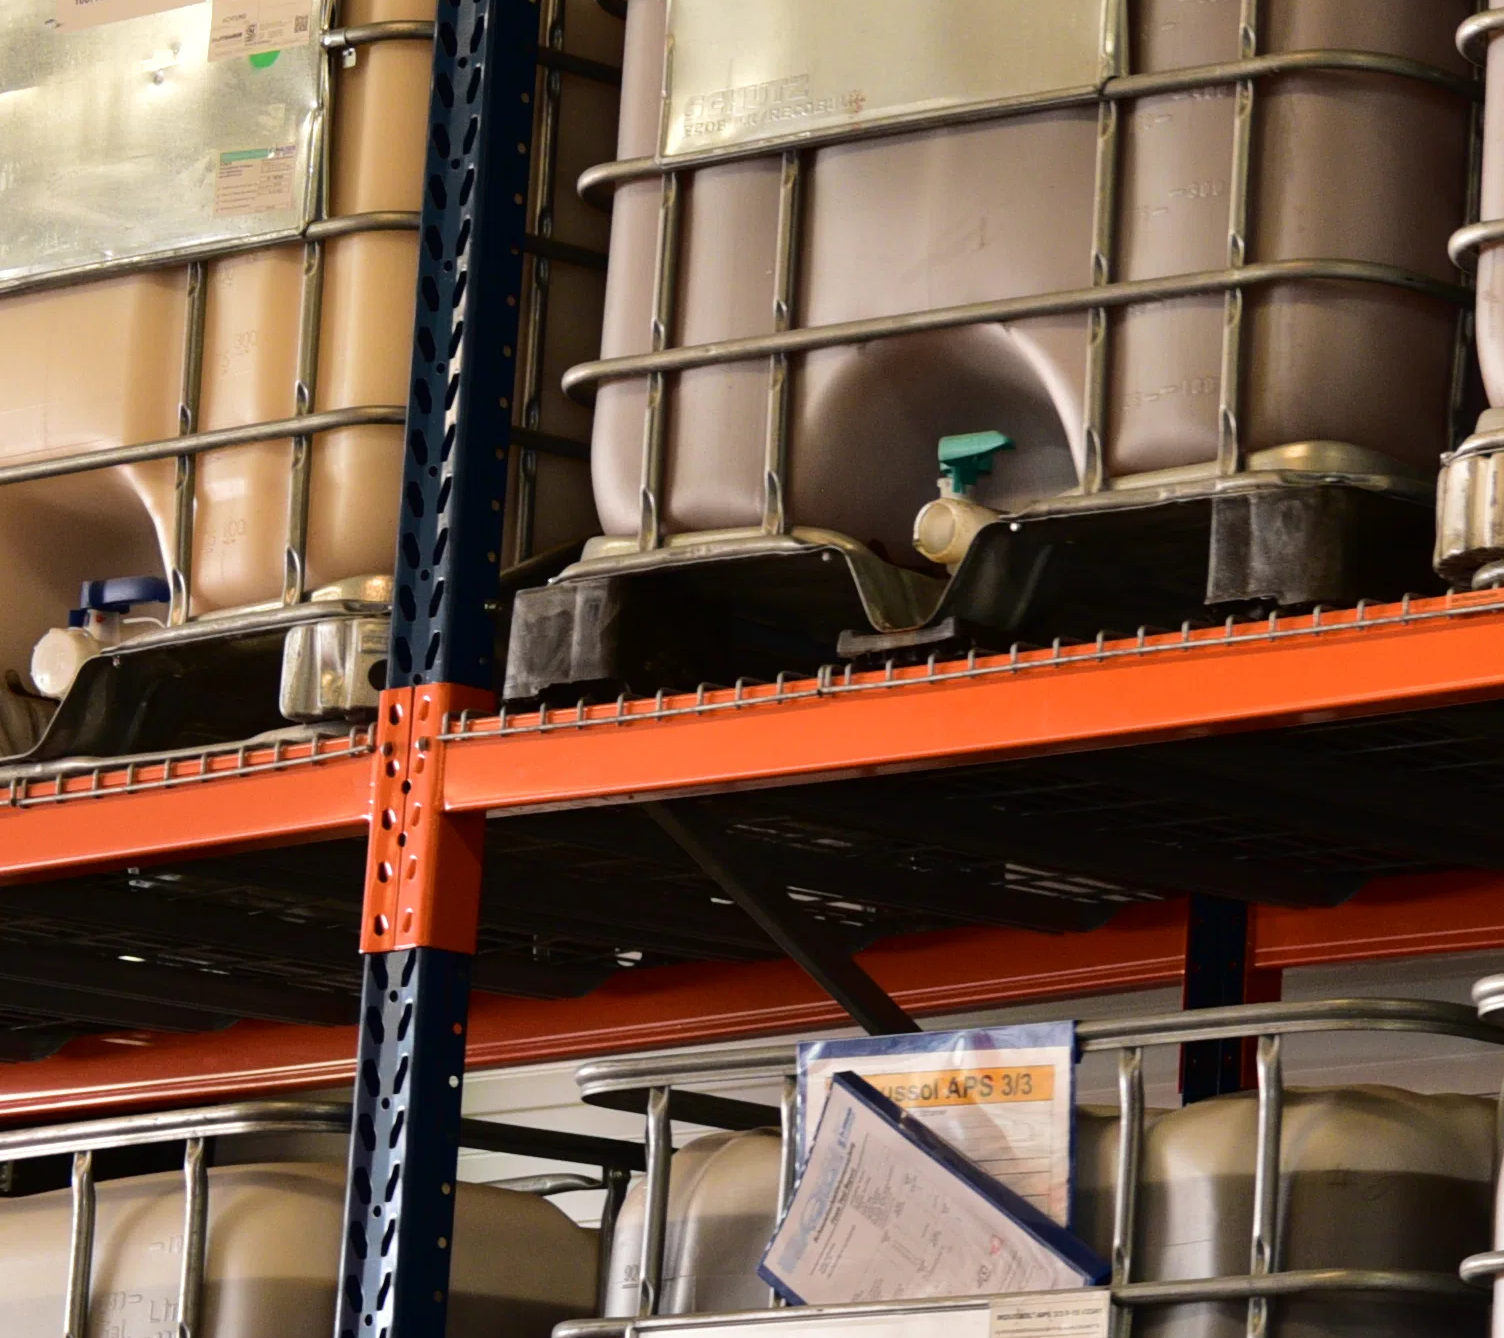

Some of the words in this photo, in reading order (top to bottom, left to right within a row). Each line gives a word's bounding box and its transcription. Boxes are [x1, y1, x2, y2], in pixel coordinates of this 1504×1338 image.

[882, 1082, 939, 1102] ussol
[946, 1075, 994, 1099] APS
[1002, 1073, 1033, 1096] 3/3
